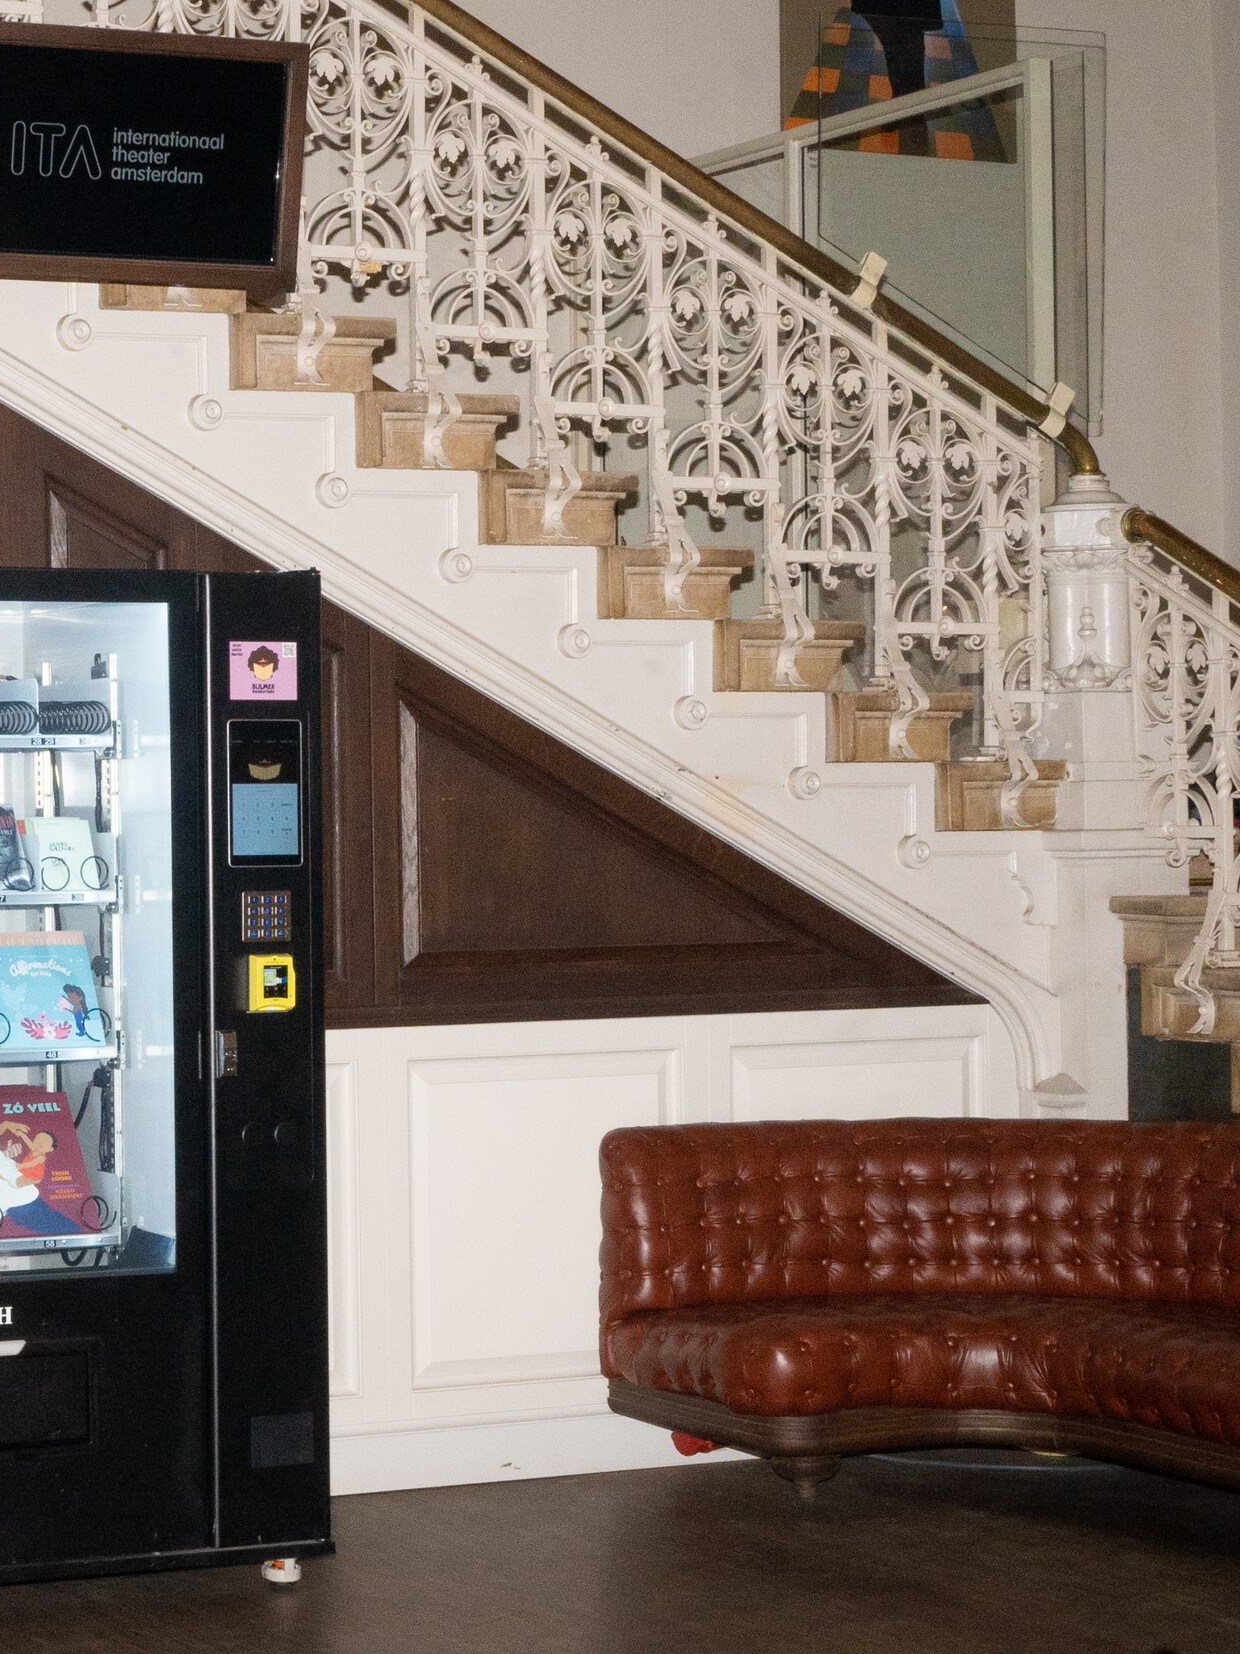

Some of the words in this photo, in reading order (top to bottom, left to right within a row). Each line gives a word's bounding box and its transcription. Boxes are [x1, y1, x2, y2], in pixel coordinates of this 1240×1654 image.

[113, 127, 224, 150] internationaal
[10, 120, 102, 180] ITA
[111, 146, 171, 165] theater
[111, 166, 204, 185] amsterdam
[2, 1101, 25, 1114] ZÓ
[27, 1102, 61, 1113] VEEL
